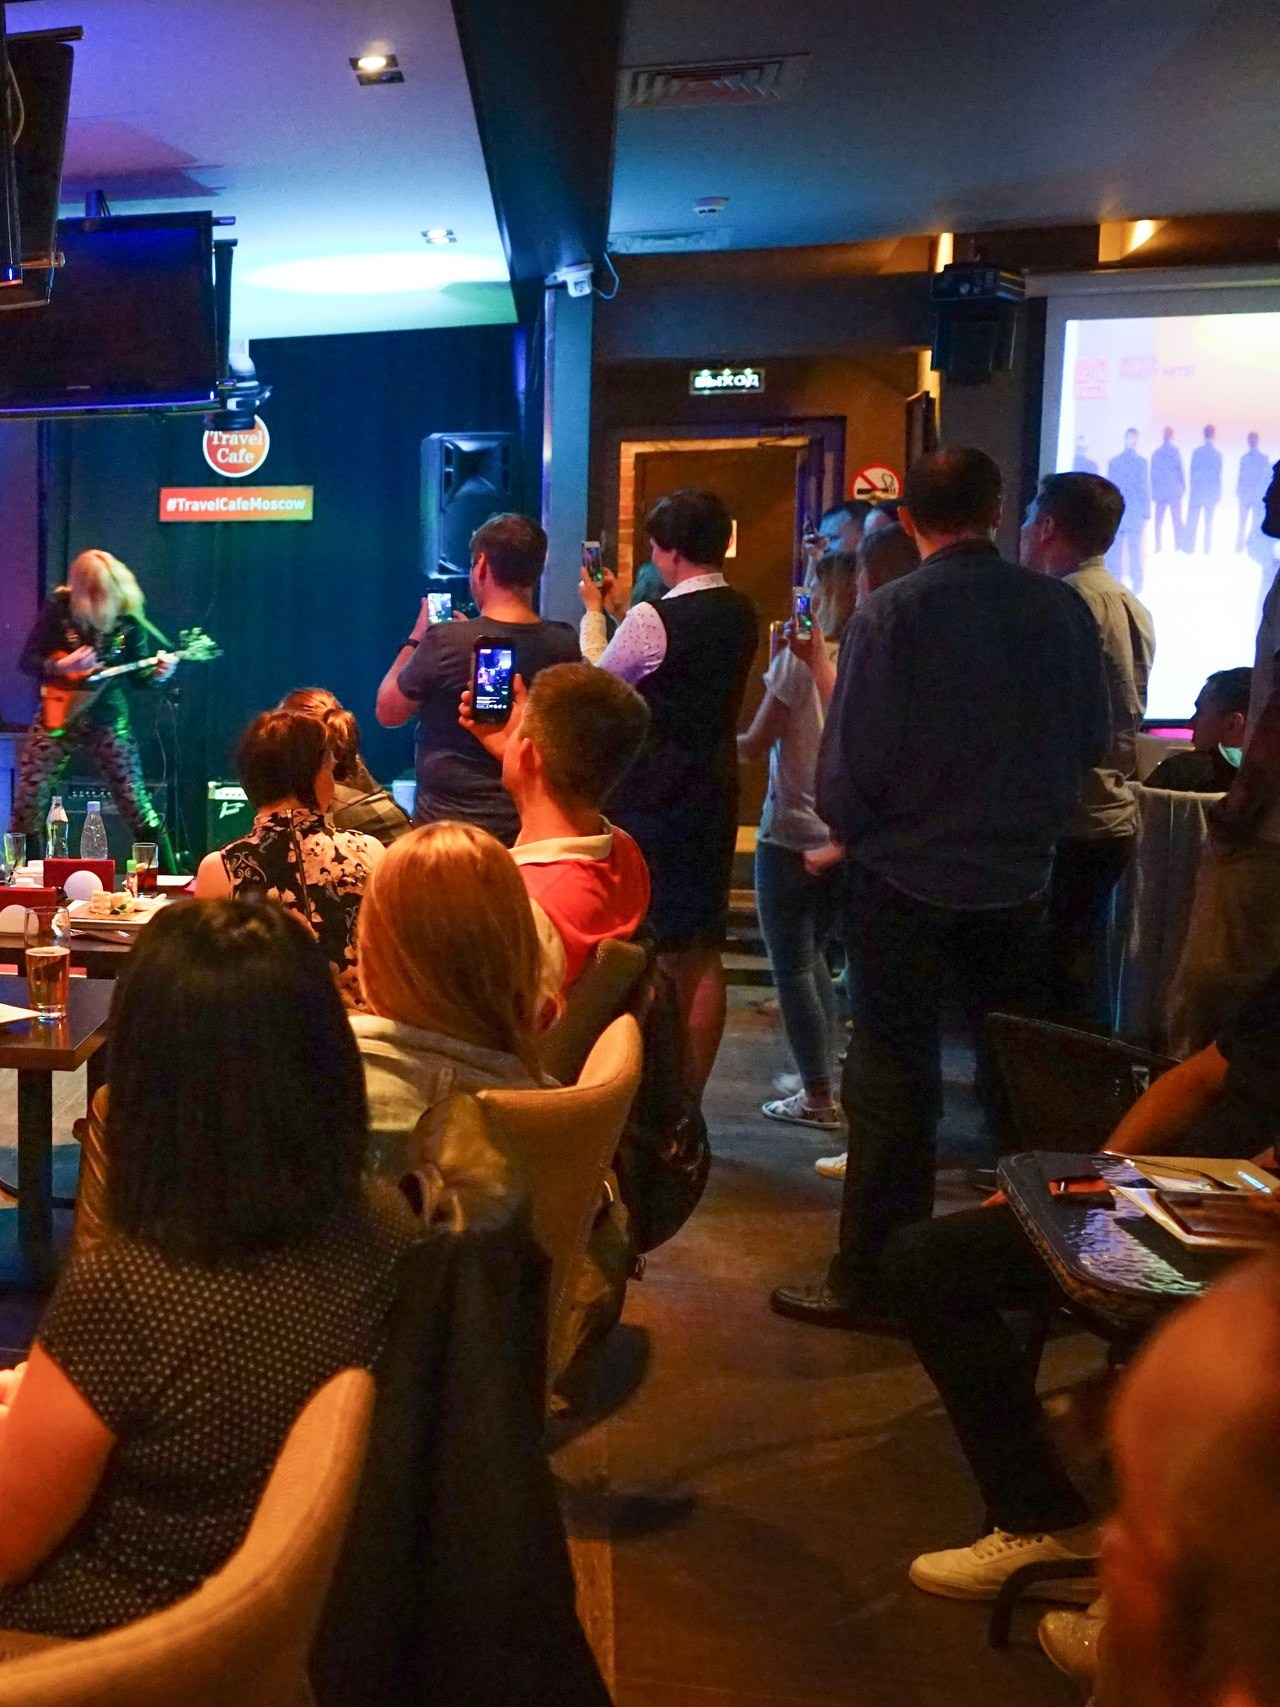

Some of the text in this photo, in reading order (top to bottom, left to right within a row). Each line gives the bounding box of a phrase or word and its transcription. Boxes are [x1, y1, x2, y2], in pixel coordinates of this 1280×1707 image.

[209, 430, 263, 446] Travel
[216, 447, 254, 463] Cafe
[166, 497, 306, 512] #TravelCafeMoscow
